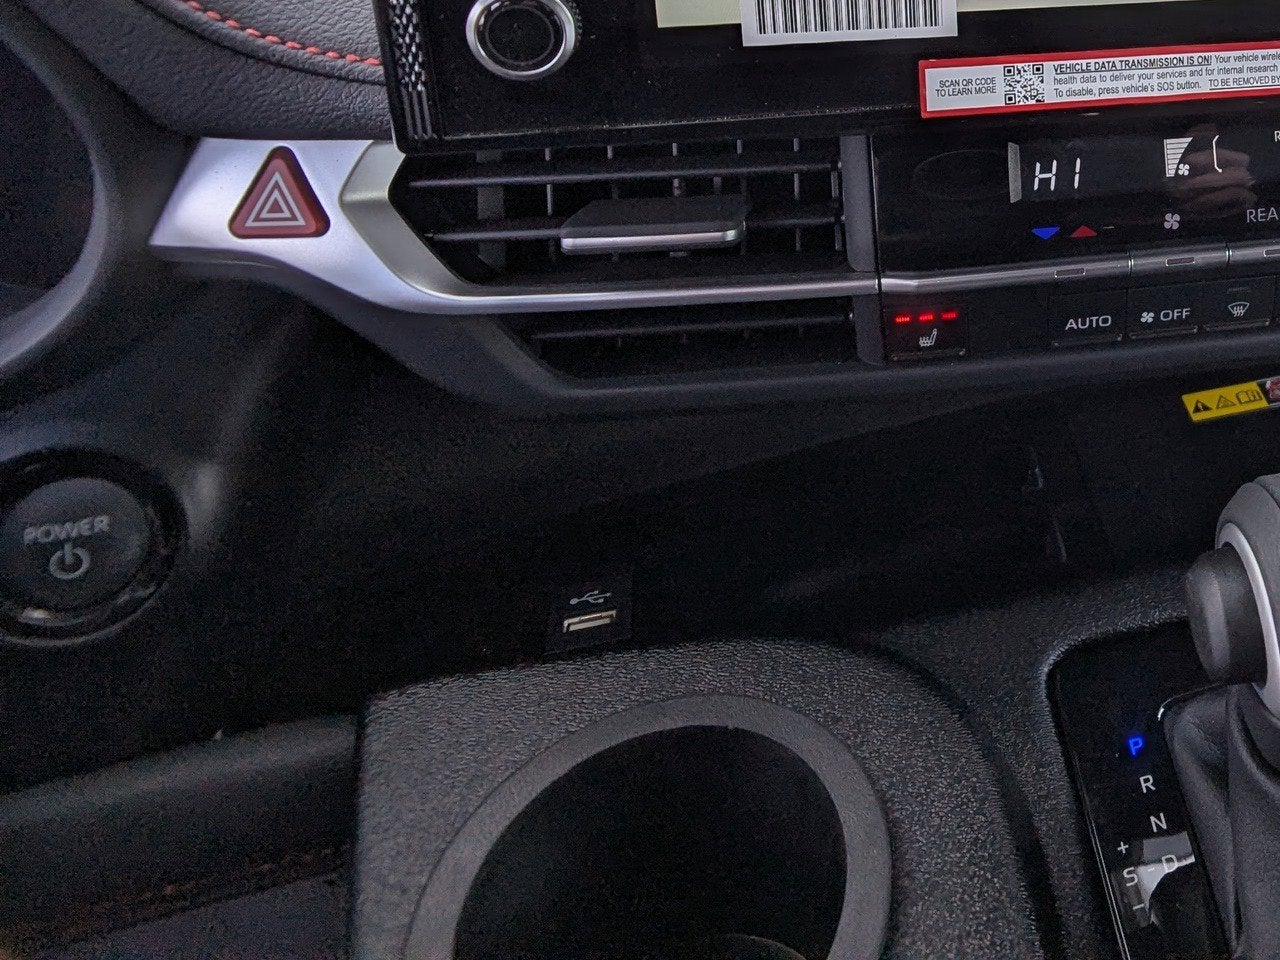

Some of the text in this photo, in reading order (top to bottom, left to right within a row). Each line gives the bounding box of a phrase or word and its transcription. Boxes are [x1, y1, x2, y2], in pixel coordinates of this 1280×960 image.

[1053, 62, 1092, 73] VEHICLE
[1094, 60, 1117, 71] DATA
[1119, 56, 1184, 69] TRANSMISSION
[1187, 56, 1194, 65] IS
[1215, 54, 1231, 63] Your
[1233, 53, 1259, 63] vehicle
[939, 77, 996, 88] SCAN QR CODE
[1053, 76, 1078, 86] health
[1080, 75, 1097, 84] data
[1100, 74, 1107, 82] to
[1109, 72, 1135, 82] deliver
[1137, 72, 1155, 83] your
[1156, 69, 1187, 80] services
[1189, 68, 1203, 77] and
[1205, 67, 1216, 76] for
[1217, 65, 1244, 75] internal
[1246, 64, 1278, 74] research
[936, 86, 996, 97] TO LEARN MORE
[1053, 88, 1064, 98] To
[1065, 87, 1096, 98] disable,
[1098, 86, 1120, 97] press
[1121, 83, 1155, 93] vehicle's
[1156, 81, 1175, 92] SOS
[1176, 80, 1202, 90] button.
[1208, 79, 1220, 88] TO
[1221, 78, 1231, 87] BE
[1232, 76, 1270, 86] REMOVED
[1271, 75, 1280, 84] BY
[1065, 314, 1112, 331] AUTO
[1160, 308, 1190, 322] OFF
[23, 515, 111, 544] POWER
[1128, 736, 1143, 756] P
[1139, 775, 1156, 794] R
[1150, 812, 1167, 832] N
[1123, 867, 1139, 887] S
[1162, 854, 1178, 872] D
